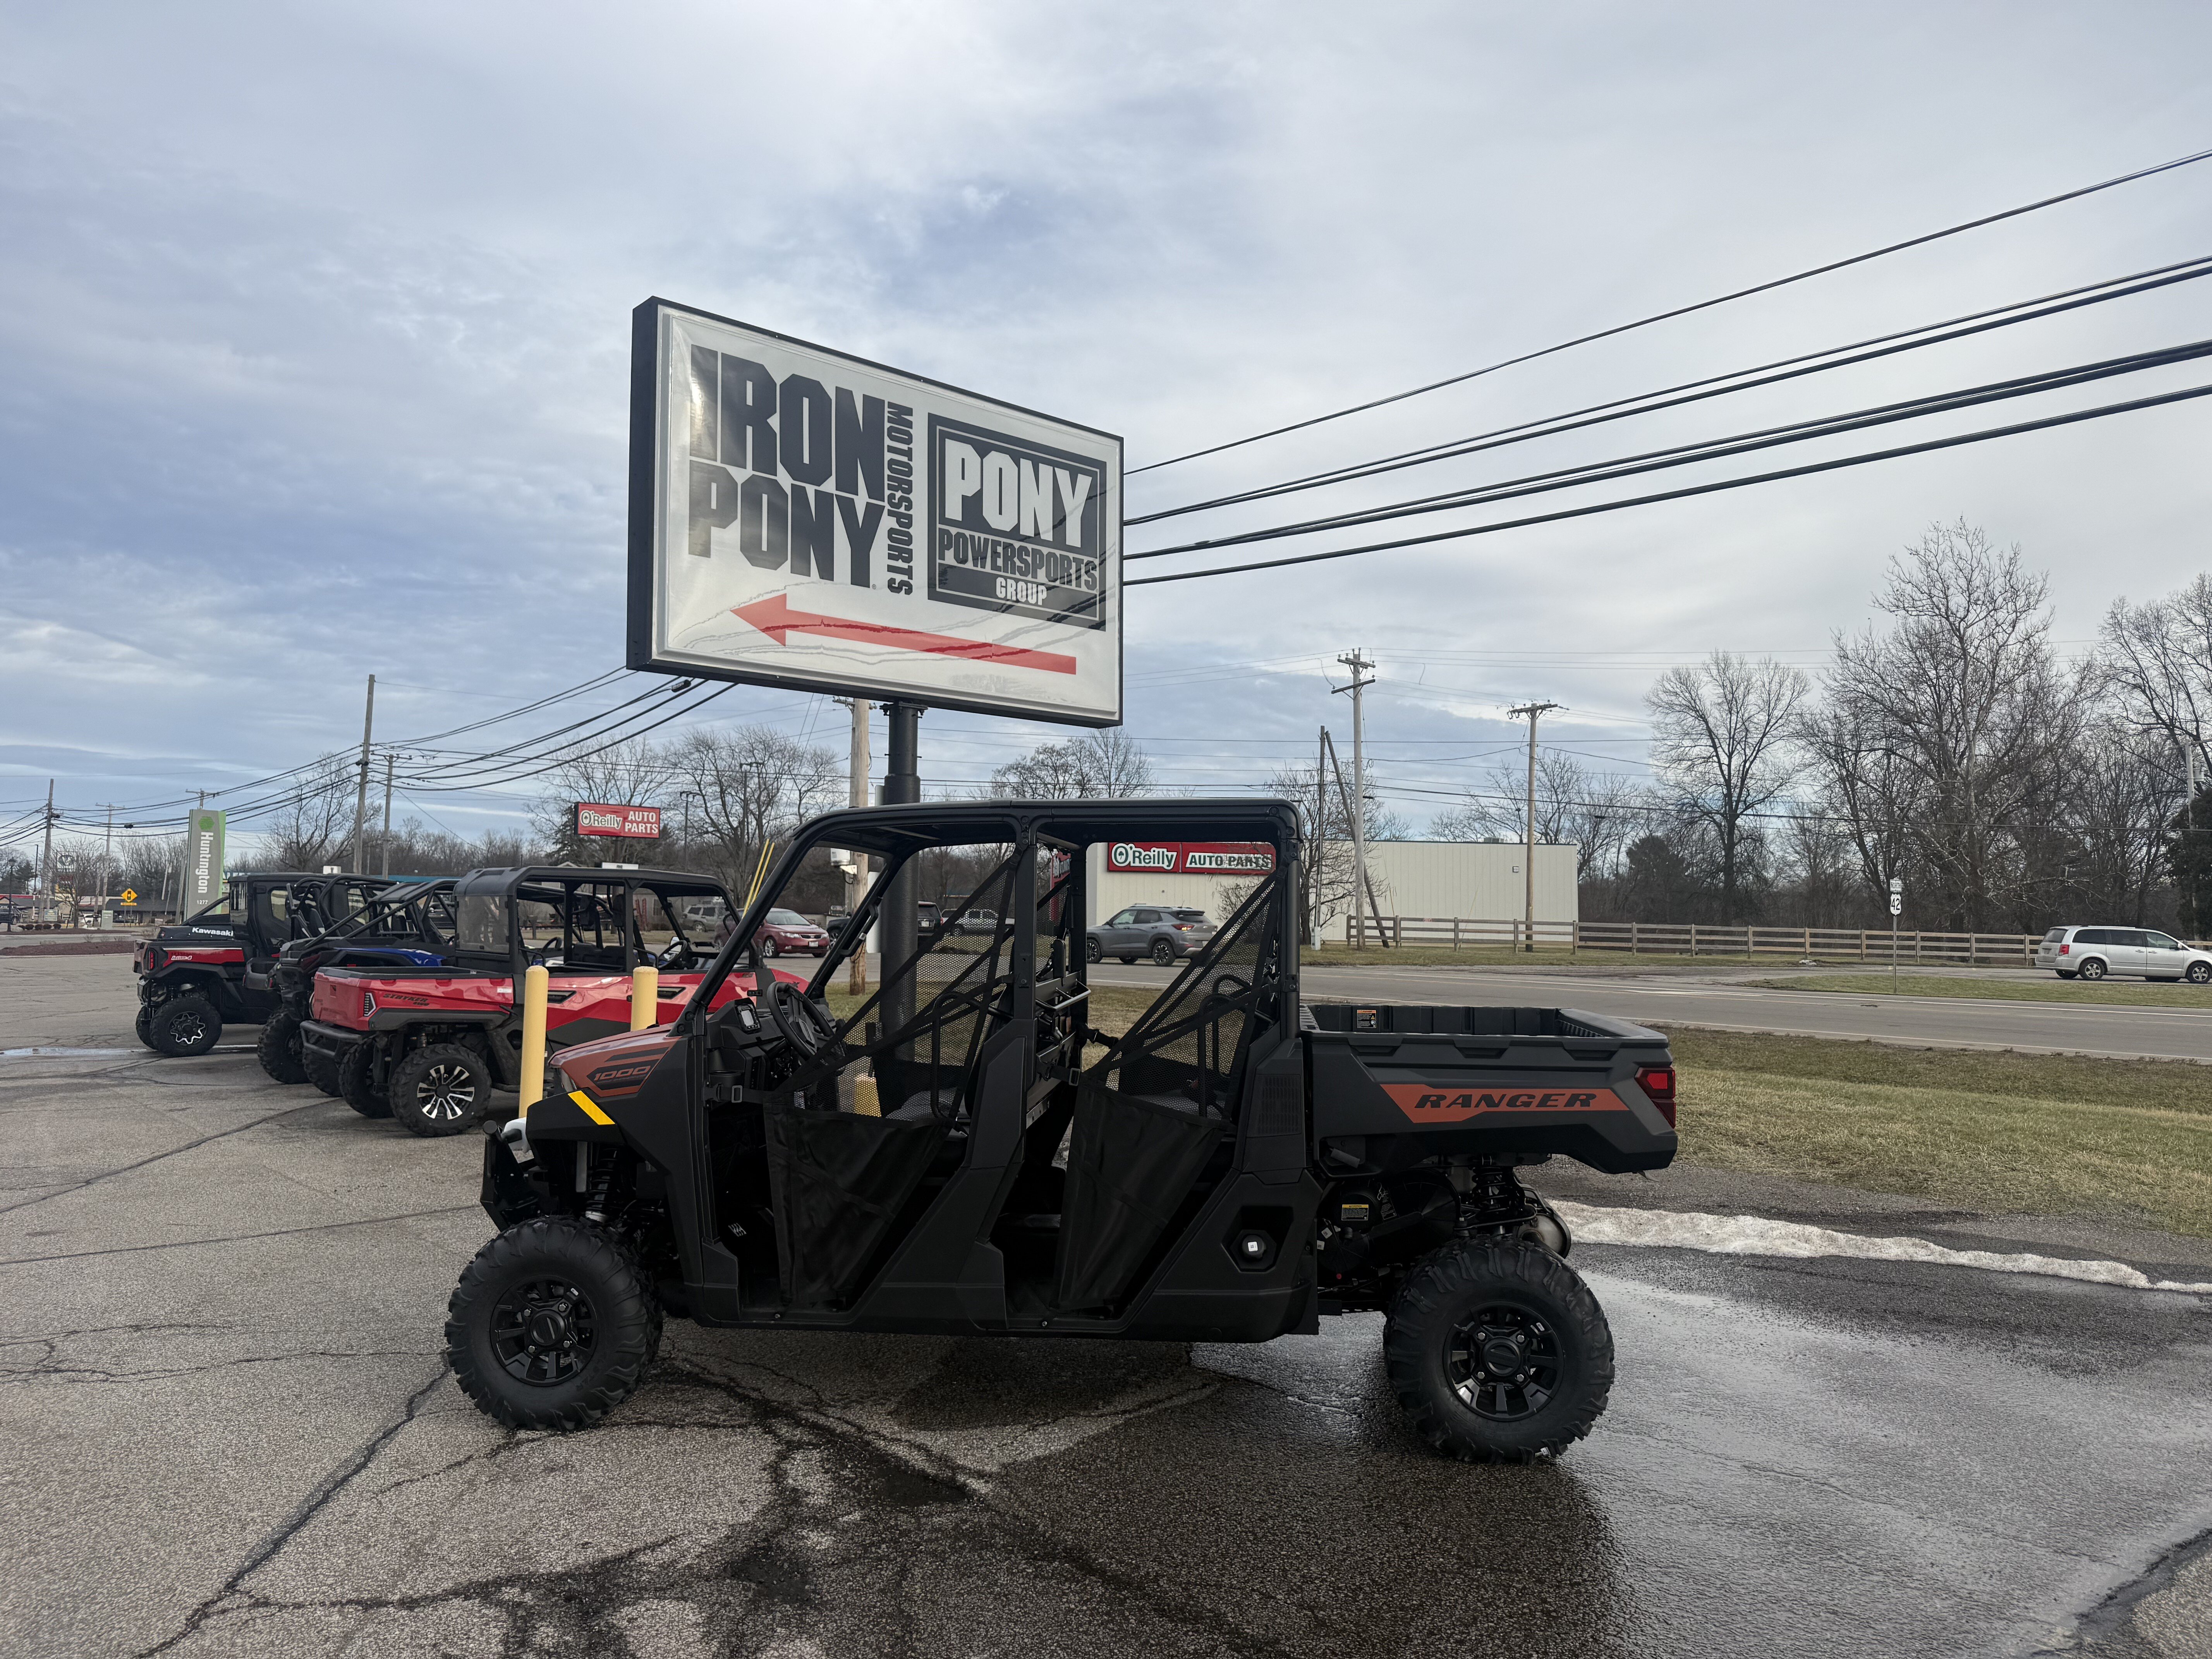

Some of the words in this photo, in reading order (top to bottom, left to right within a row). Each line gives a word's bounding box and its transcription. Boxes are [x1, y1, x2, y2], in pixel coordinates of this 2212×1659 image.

[690, 344, 885, 502] IRON
[887, 401, 913, 596] MOTORSPORTS
[945, 438, 1092, 548] PONY
[689, 460, 885, 589] PONY
[938, 527, 1097, 591] POWERSPORTS
[996, 577, 1047, 606] GROUP
[581, 811, 622, 829] O'Reilly
[628, 811, 656, 822] AUTO
[625, 822, 659, 834] PARTS
[196, 832, 214, 893] Huntington
[1114, 845, 1175, 867] O'Reilly
[1189, 855, 1224, 866] AUTO
[1228, 855, 1273, 867] PARTS
[1891, 898, 1900, 910] 42
[192, 927, 234, 937] Kawasaki
[594, 1065, 651, 1081] 1000
[1414, 1093, 1597, 1108] RANGER
